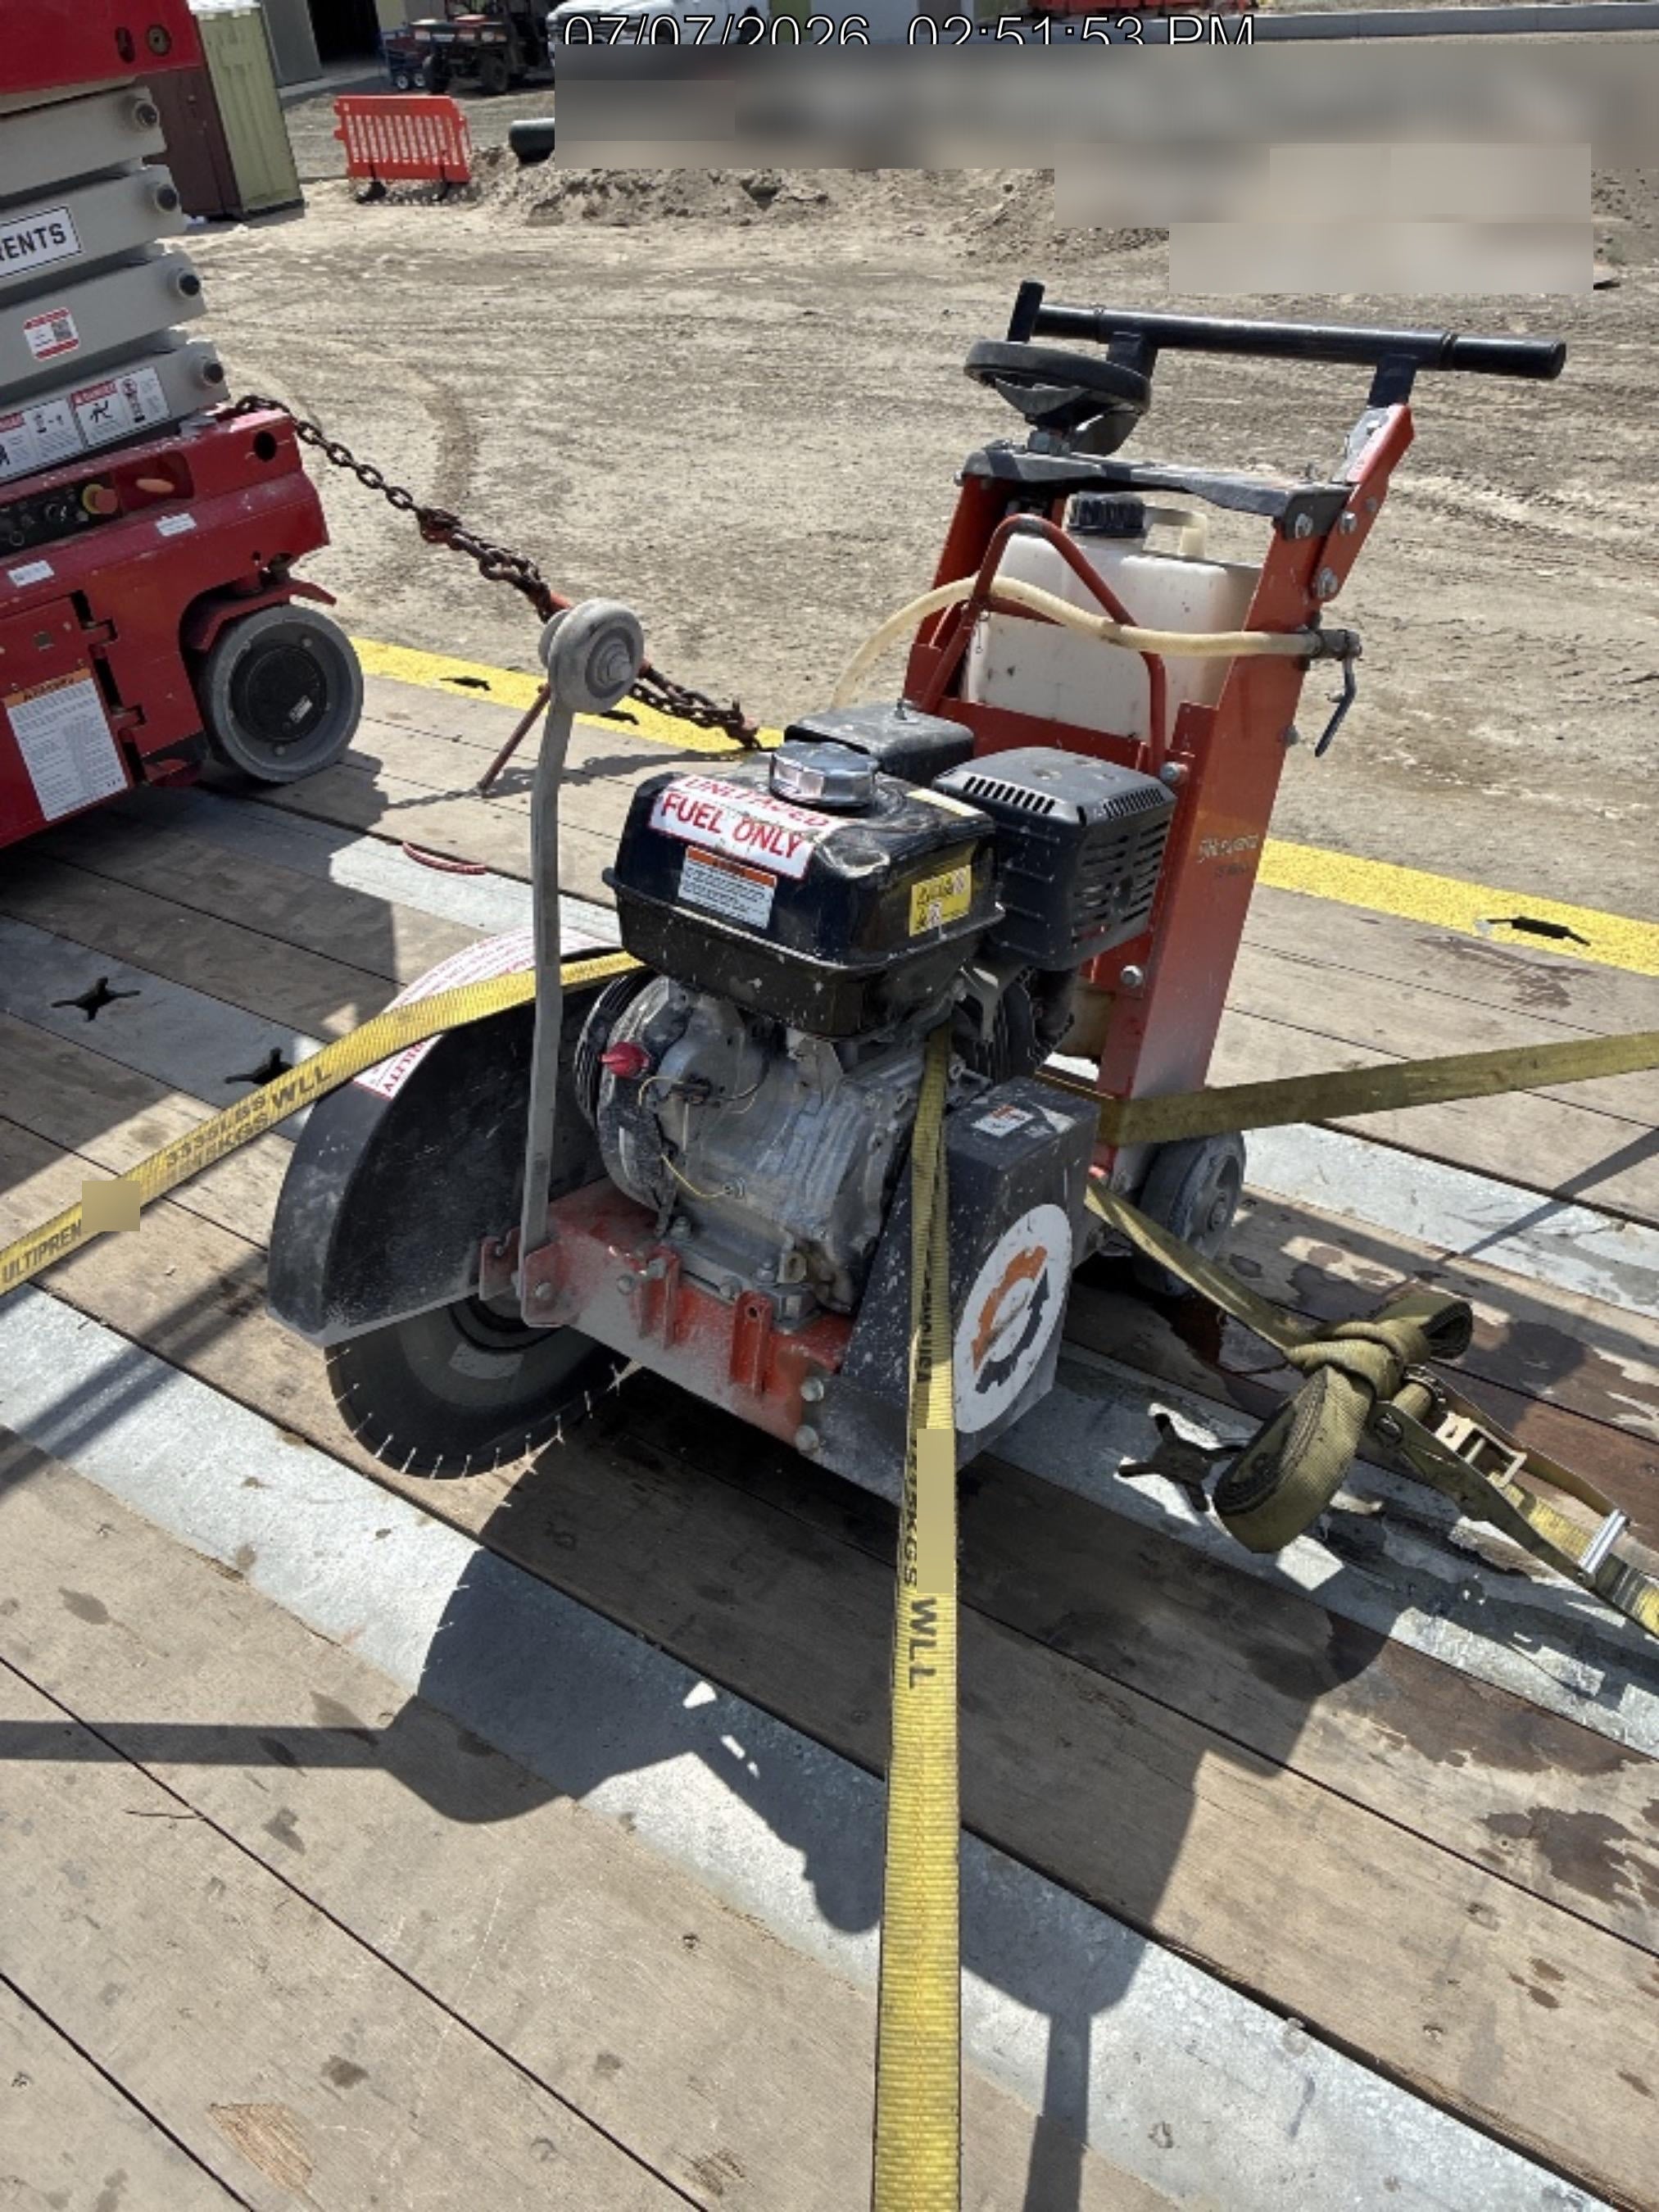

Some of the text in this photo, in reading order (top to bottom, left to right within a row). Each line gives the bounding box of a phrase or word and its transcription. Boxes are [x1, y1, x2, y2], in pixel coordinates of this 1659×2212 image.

[0, 223, 66, 261] ENTS
[660, 791, 804, 859] FUEL ONLY
[271, 1067, 333, 1109] WLL
[909, 1598, 937, 1688] WLL
